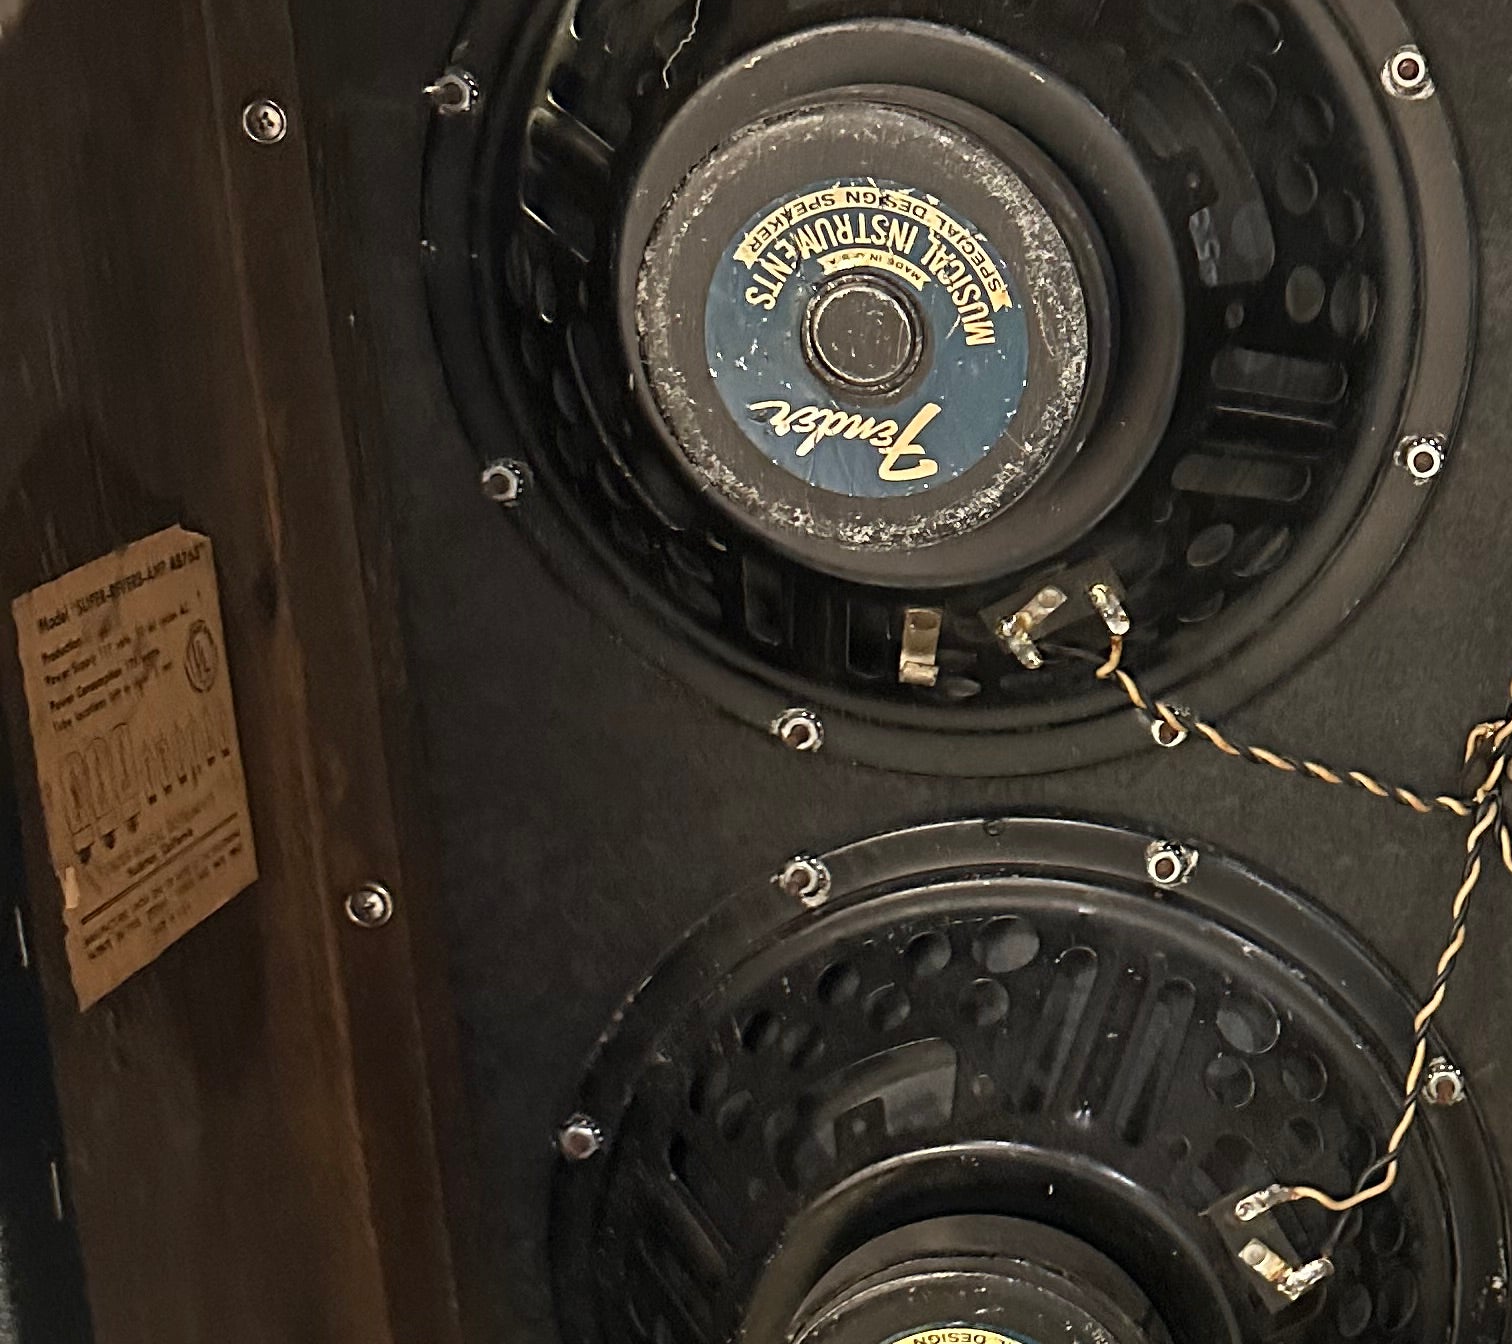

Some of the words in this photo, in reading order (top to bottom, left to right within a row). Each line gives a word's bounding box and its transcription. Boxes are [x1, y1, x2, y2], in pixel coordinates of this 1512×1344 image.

[749, 192, 835, 253] SPEAKER
[846, 190, 926, 220] DESIGN
[745, 212, 918, 311] INSTRUMENTS
[869, 252, 882, 261] IN
[920, 229, 996, 346] MUSICAL
[936, 214, 1002, 293] SPECIAL
[746, 400, 941, 482] Fender
